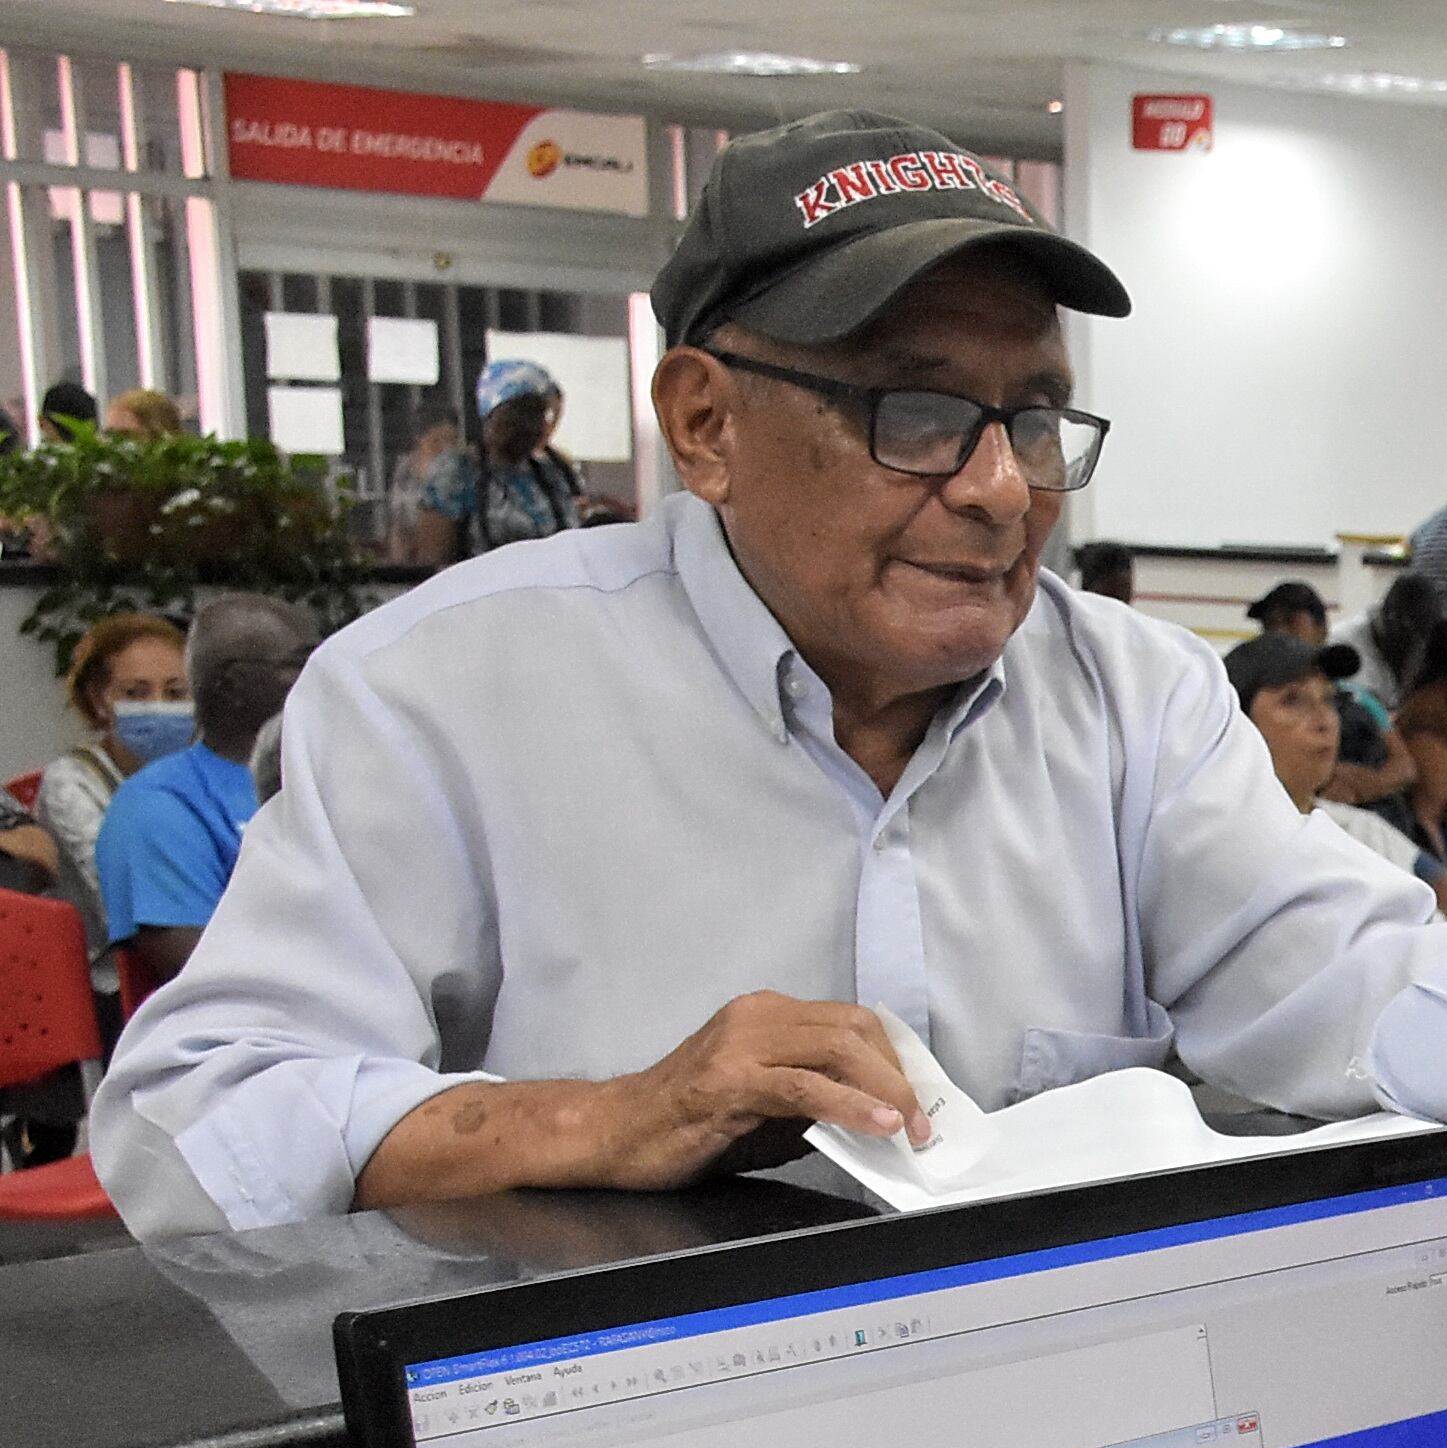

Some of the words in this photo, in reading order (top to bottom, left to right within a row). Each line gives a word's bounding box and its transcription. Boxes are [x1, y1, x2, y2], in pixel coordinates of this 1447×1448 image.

[231, 118, 313, 149] SALIDA
[317, 127, 348, 153] DE
[351, 130, 484, 165] EMERGENCIA
[412, 1387, 448, 1405] Accion
[457, 1378, 493, 1397] Edicion
[504, 1369, 542, 1388] Ventana
[552, 1361, 583, 1379] Ayuda
